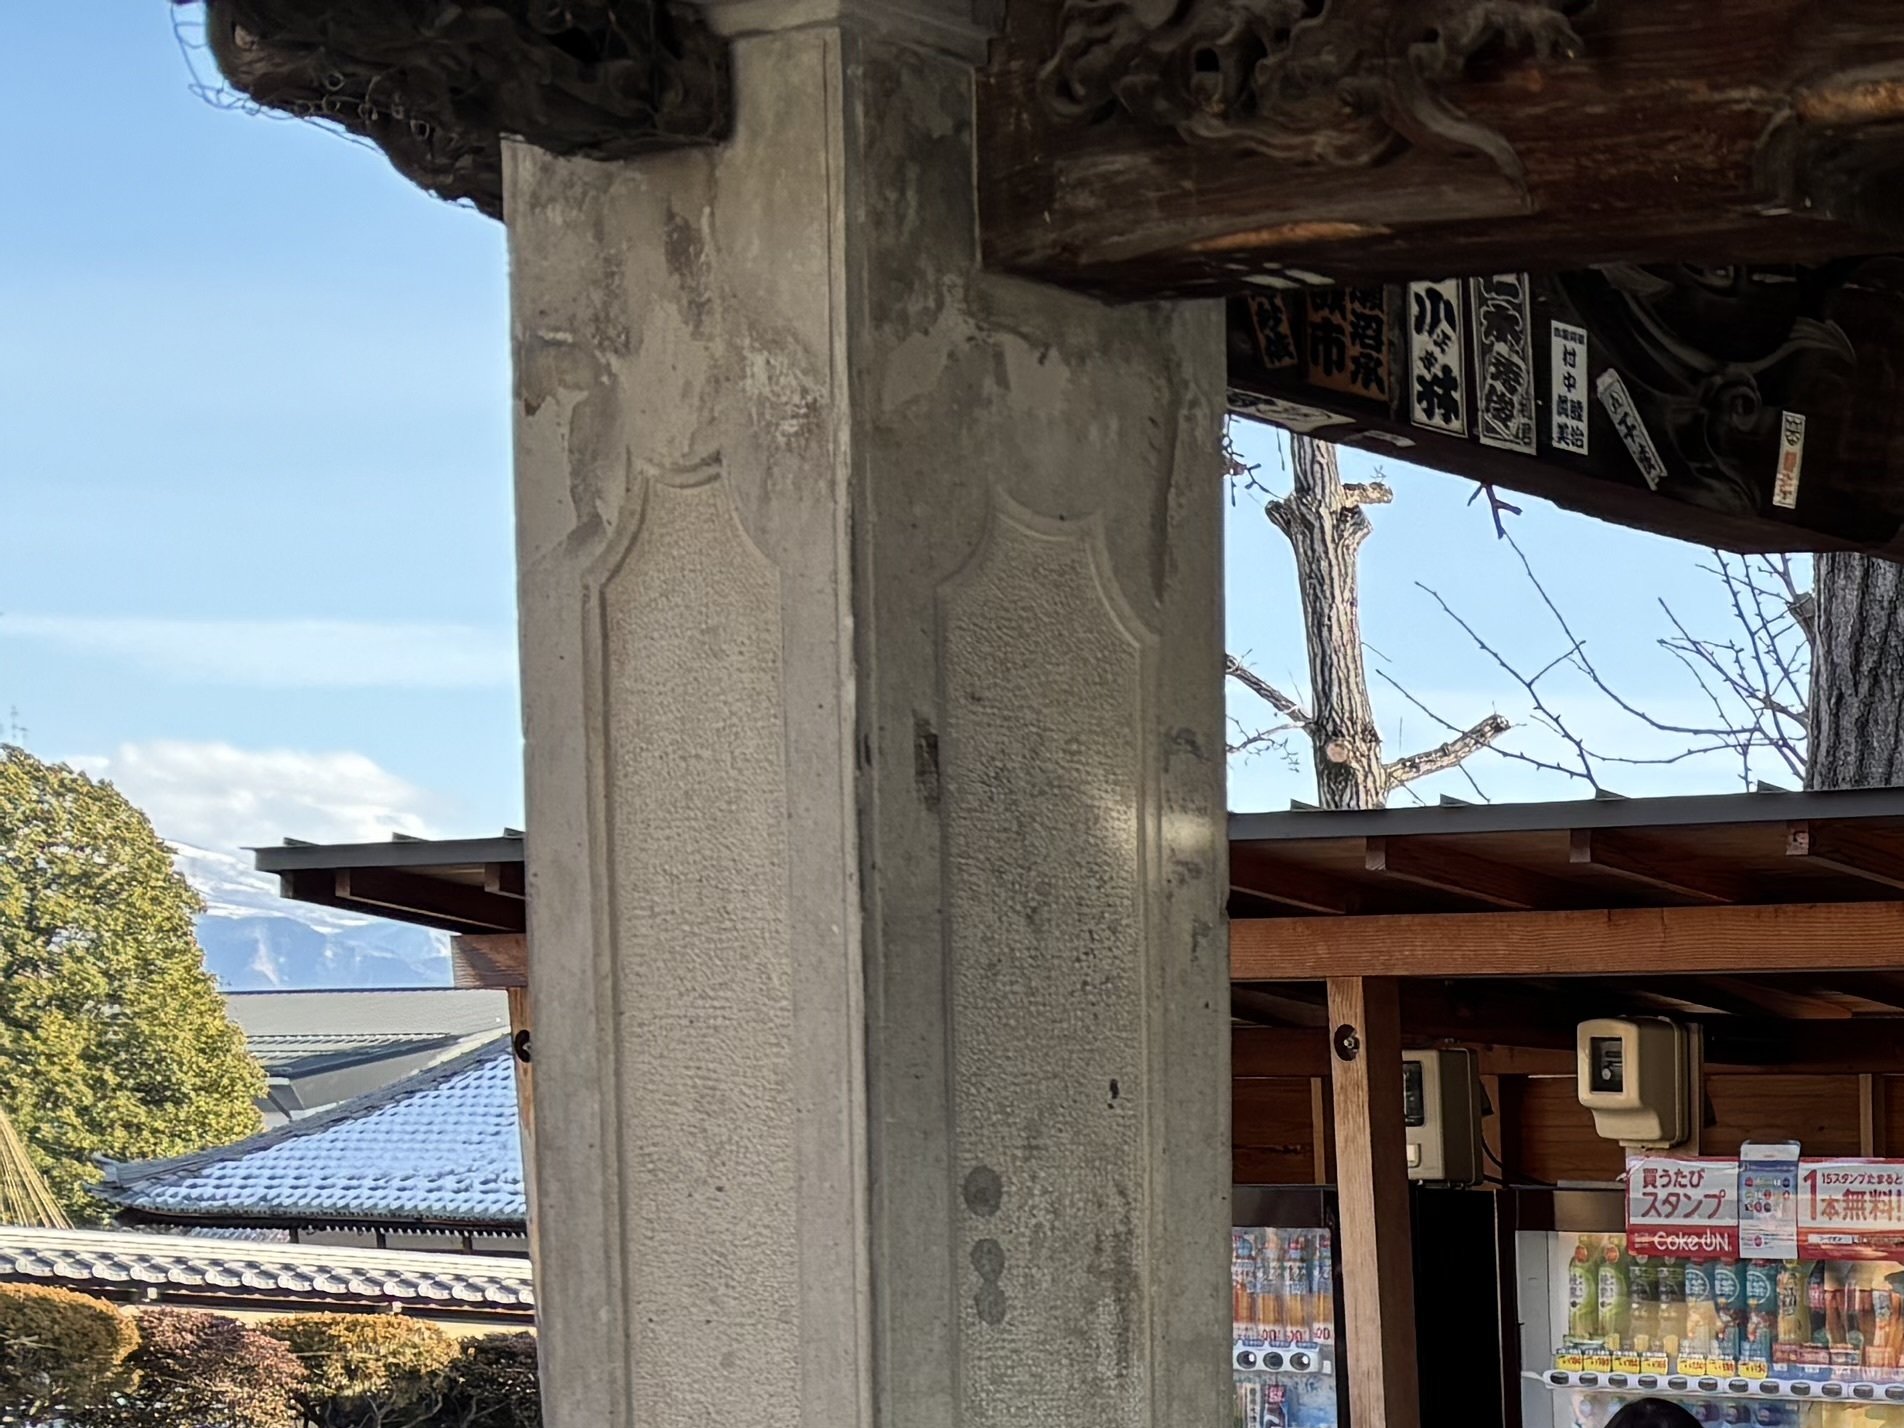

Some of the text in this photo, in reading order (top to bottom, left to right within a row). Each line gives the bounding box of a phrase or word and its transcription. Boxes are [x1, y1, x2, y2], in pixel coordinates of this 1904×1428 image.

[1642, 1167, 1705, 1189] 買うたび
[1641, 1190, 1727, 1220] スタンプ
[1653, 1231, 1699, 1251] Coke
